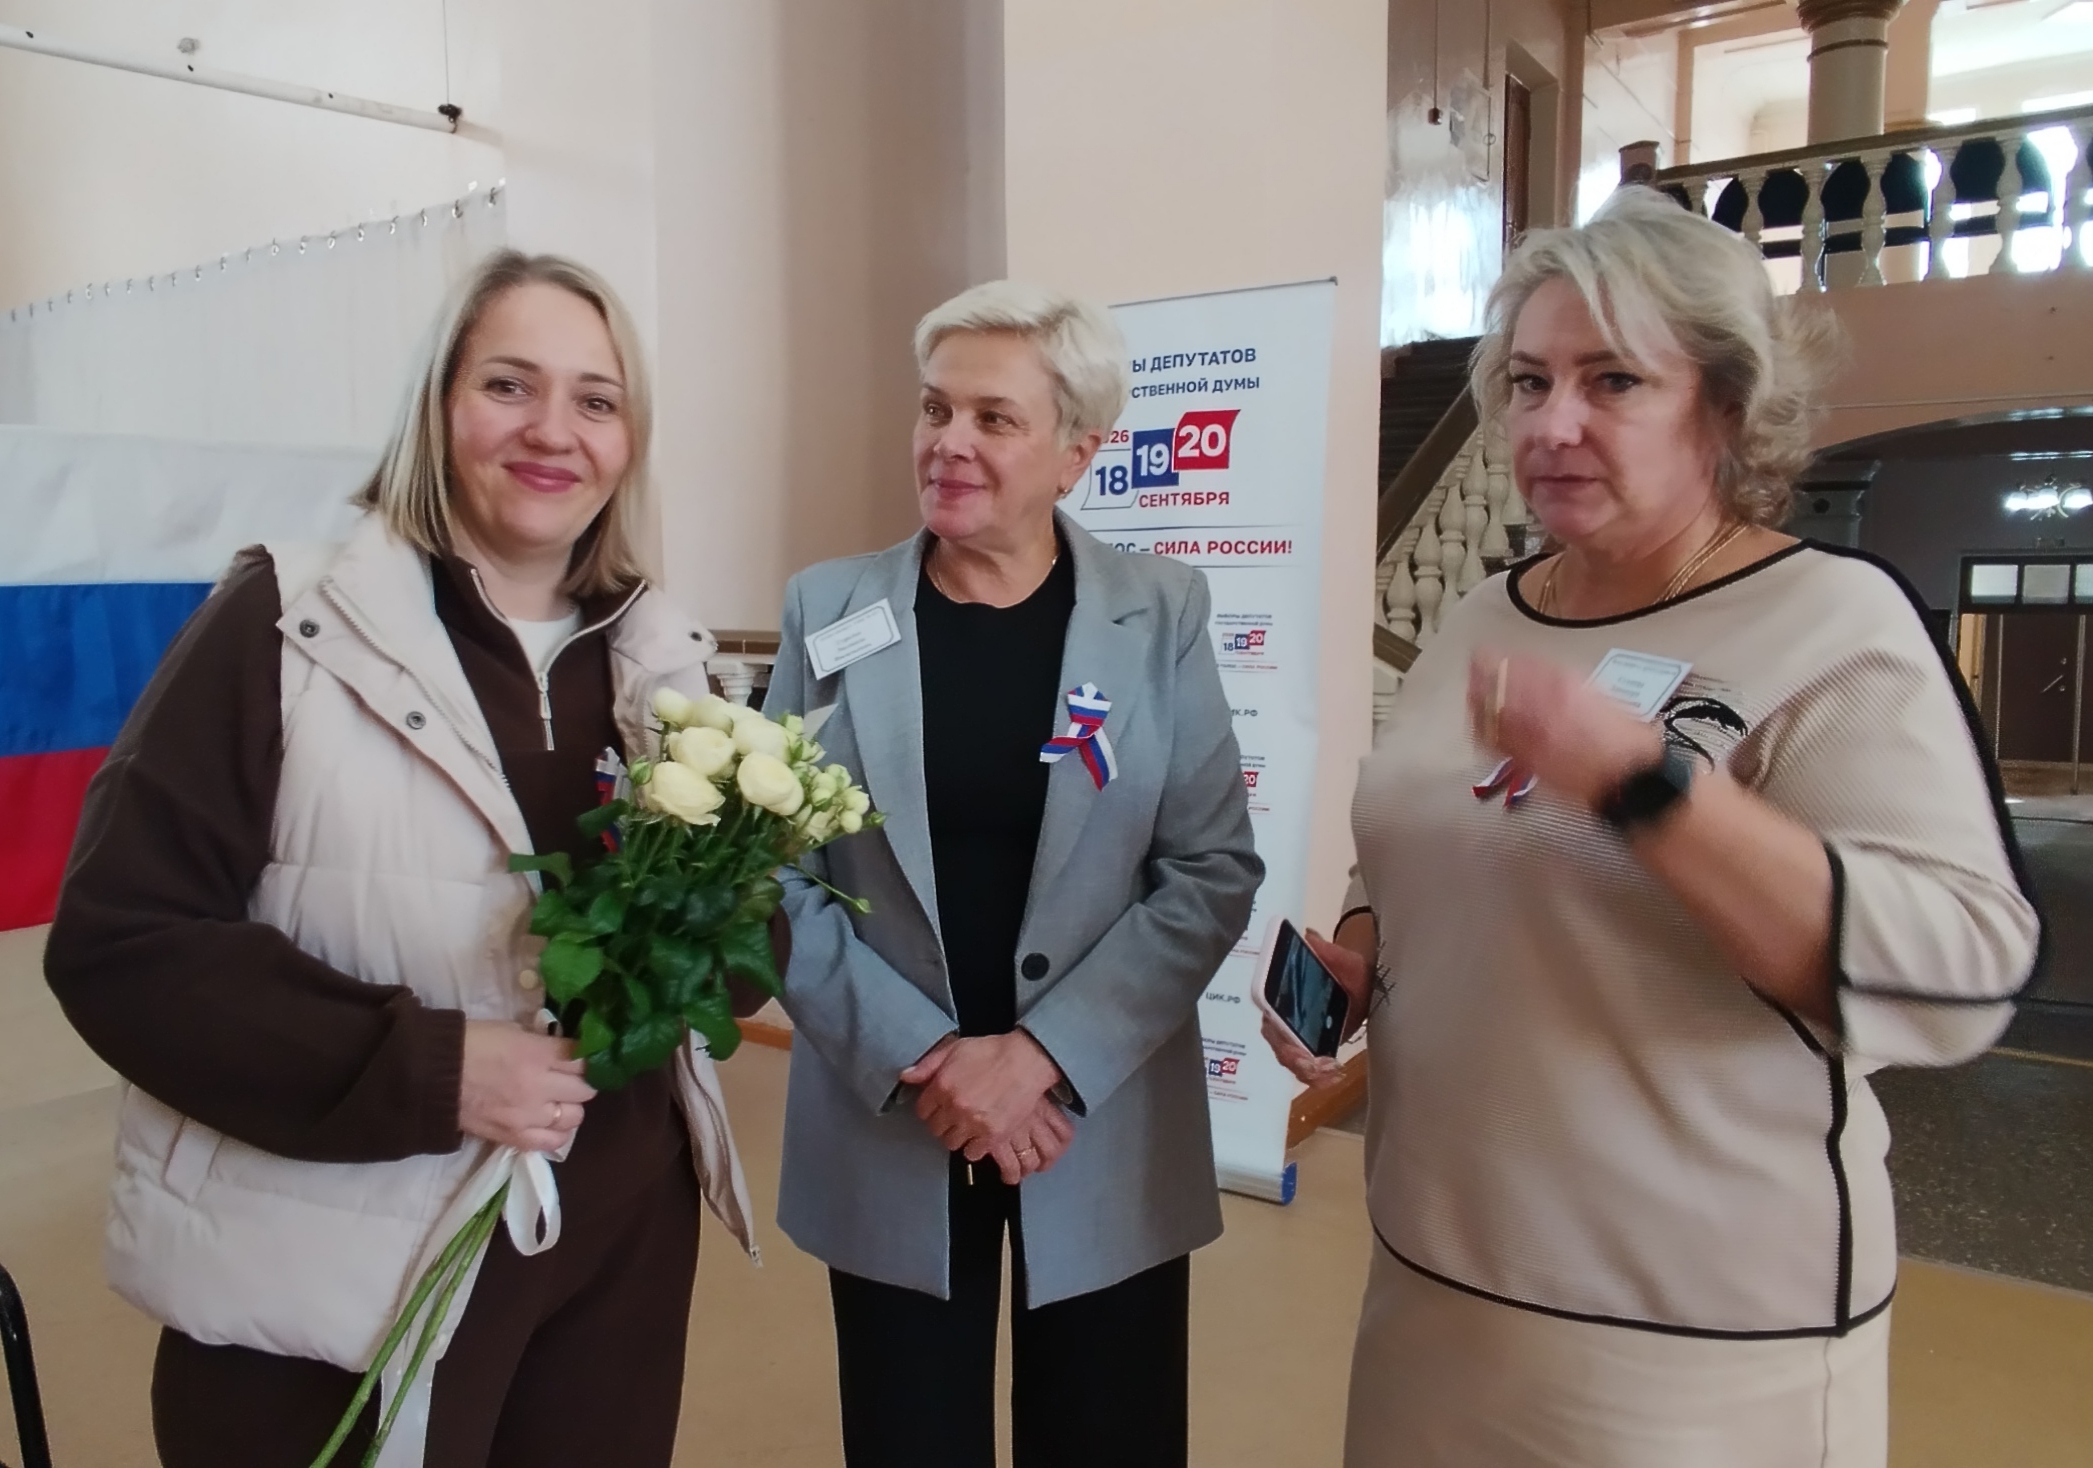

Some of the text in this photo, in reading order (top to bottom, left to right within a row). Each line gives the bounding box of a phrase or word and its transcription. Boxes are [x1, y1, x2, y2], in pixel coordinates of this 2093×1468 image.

[1150, 348, 1256, 373] ДЕПУТАТОВ
[1130, 377, 1260, 398] СТВЕННОЙ ДУМЫ
[1106, 430, 1129, 444] 26
[1095, 424, 1227, 496] 18 19 20
[1139, 492, 1230, 508] СЕНТЯБРЯ
[1154, 541, 1201, 555] СИЛА
[1207, 540, 1292, 555] РОССИИ!
[1223, 642, 1234, 651] 18
[1249, 633, 1264, 644] 20
[1222, 1060, 1236, 1072] 20
